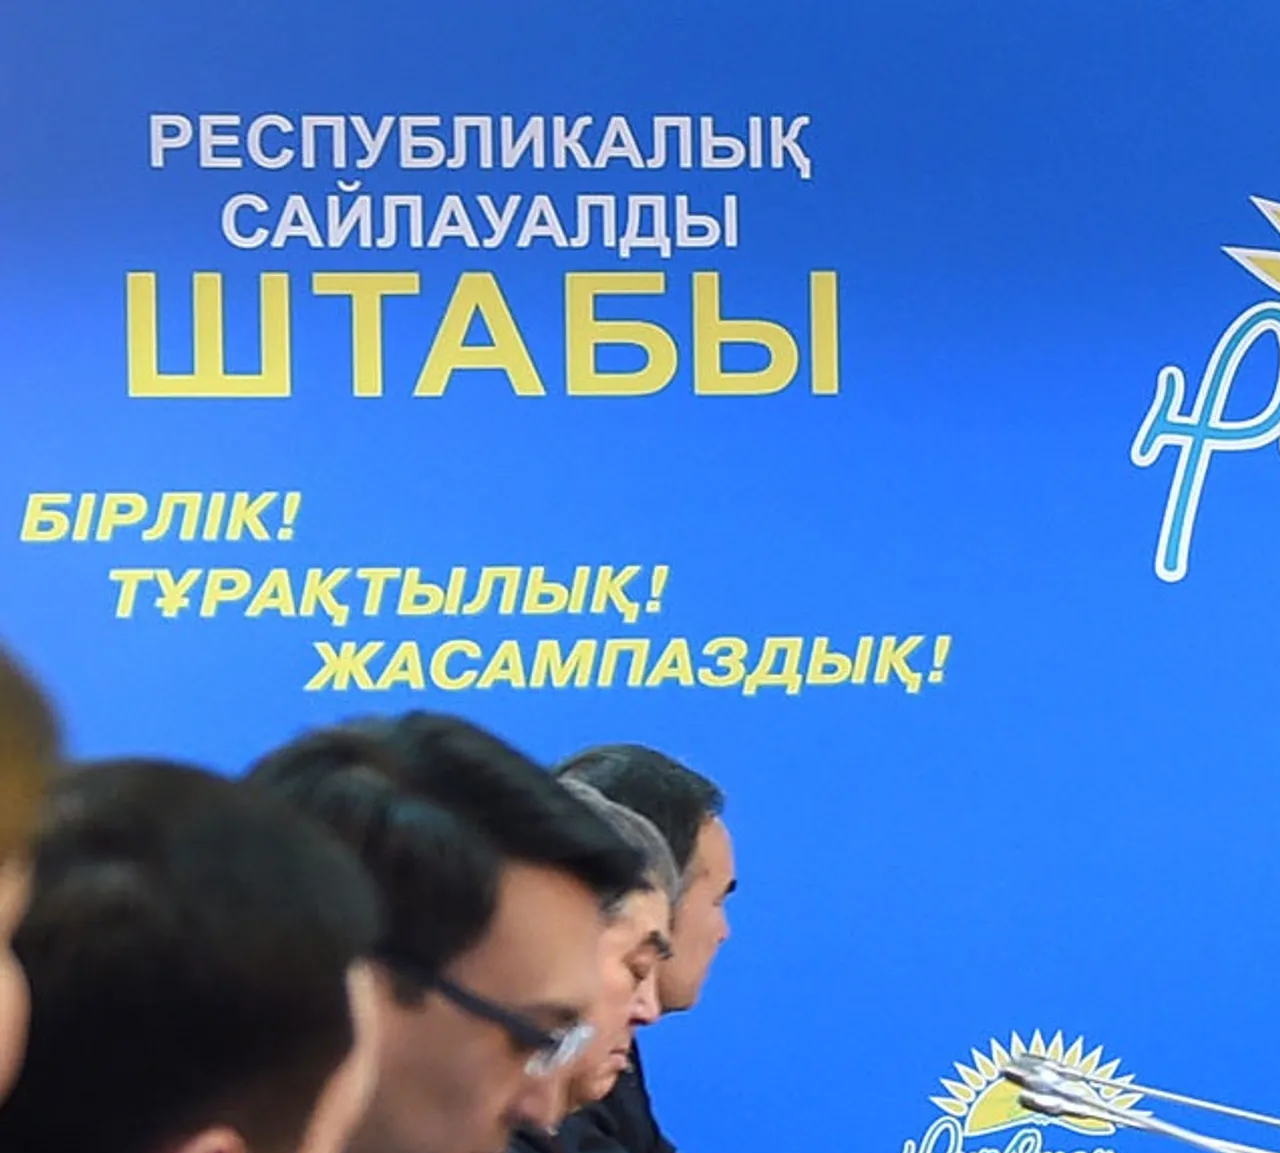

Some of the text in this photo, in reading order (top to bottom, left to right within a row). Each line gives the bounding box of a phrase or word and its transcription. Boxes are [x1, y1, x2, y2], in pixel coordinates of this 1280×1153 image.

[149, 114, 812, 180] РЕСПУБЛИКАЛЫҚ
[221, 182, 738, 258] САЙЛАУАЛДЫ
[125, 270, 840, 399] ШТАБЫ
[19, 490, 302, 543] БІРЛІК!
[108, 564, 670, 627] ТҰРАҚТЫЛЫҚ!
[304, 634, 952, 695] ЖАСАМПАЗДЫҚ!
